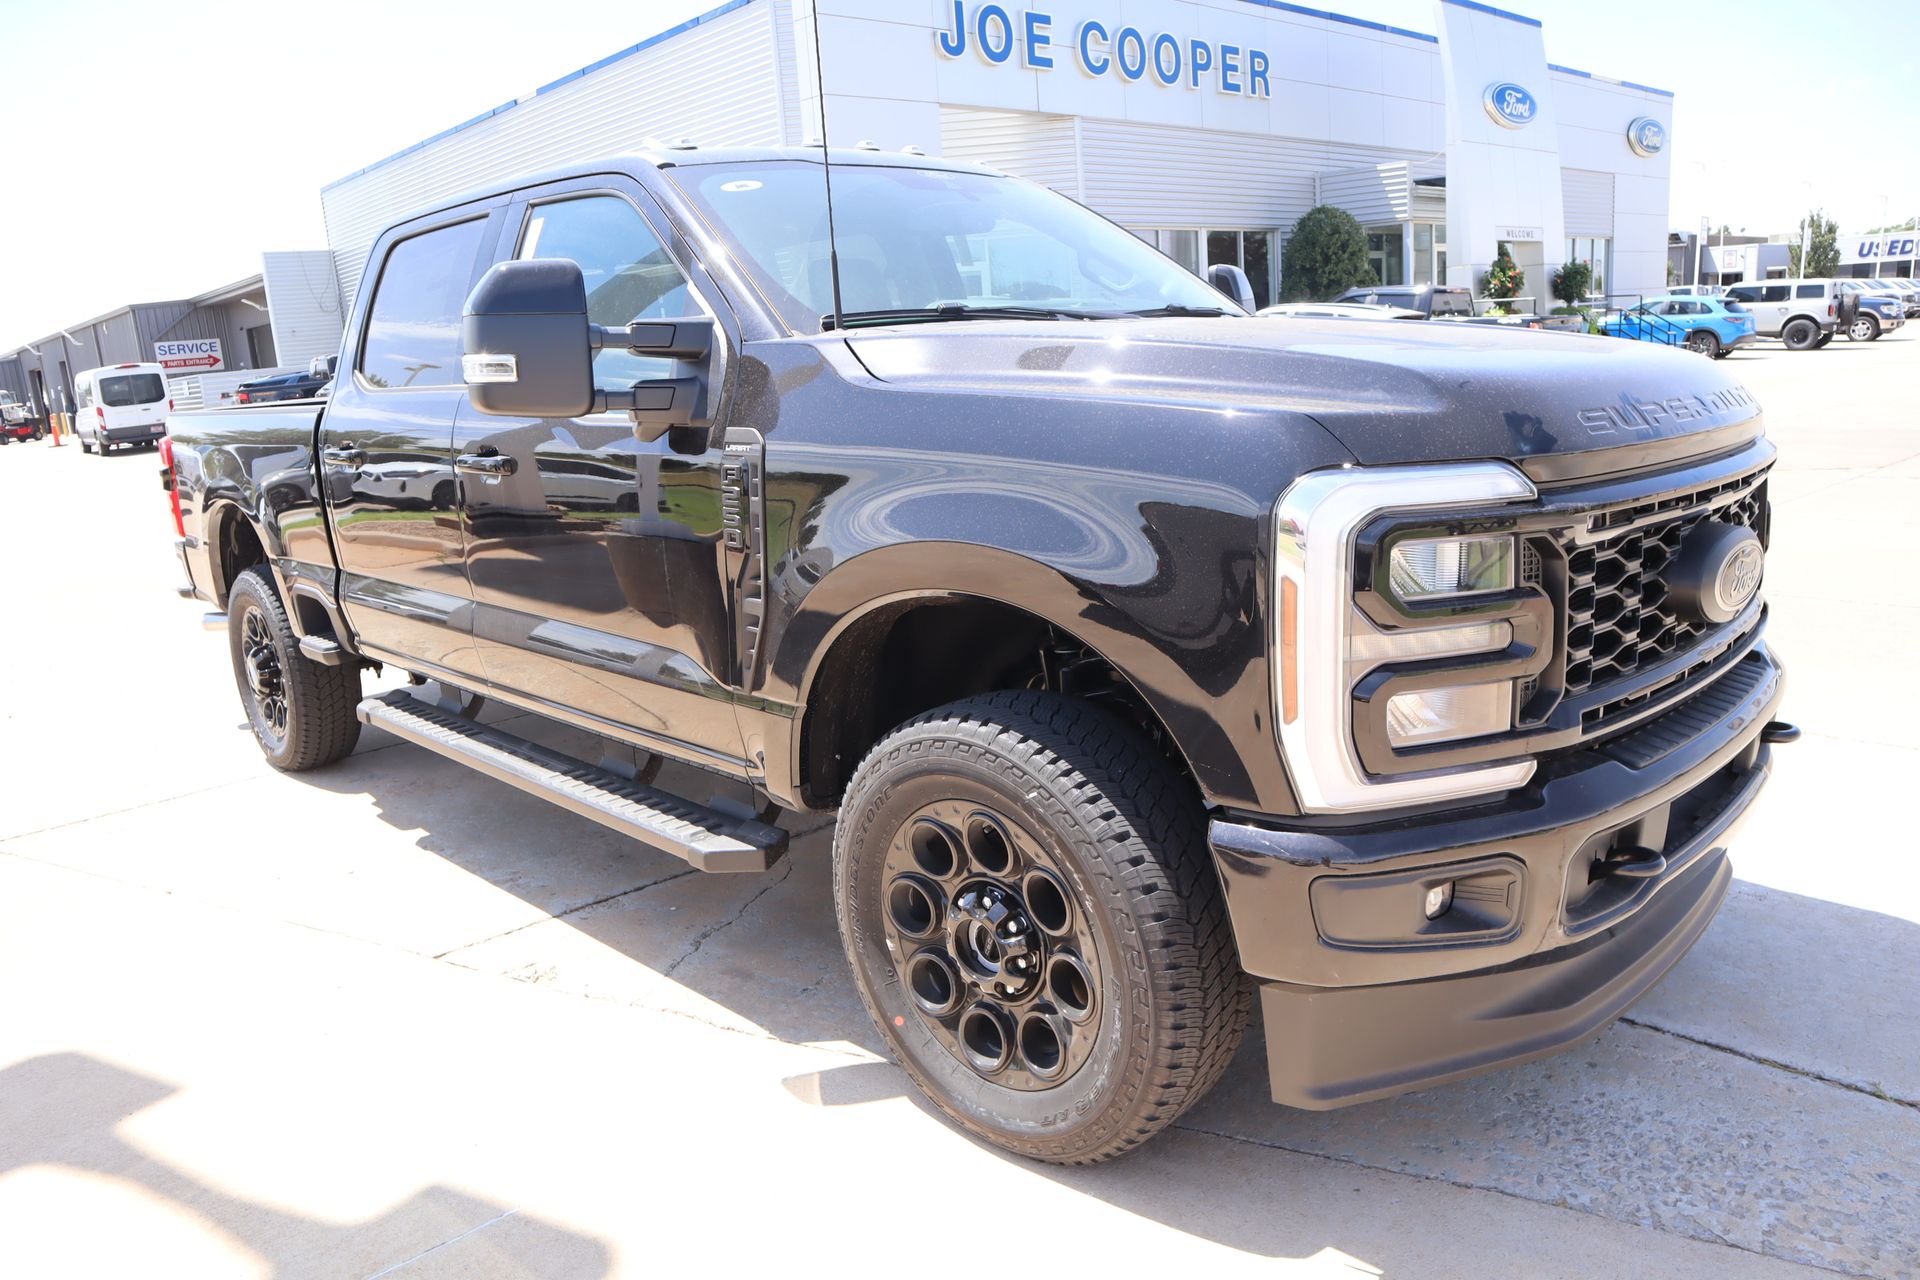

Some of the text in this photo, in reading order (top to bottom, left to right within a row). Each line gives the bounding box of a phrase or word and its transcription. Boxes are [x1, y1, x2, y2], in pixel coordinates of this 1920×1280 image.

[938, 0, 1271, 98] JOE COOPER
[1503, 89, 1531, 118] Ford
[1506, 229, 1535, 239] WELCOME
[158, 342, 218, 356] SERVICE
[185, 357, 215, 365] ENTRANCE
[1576, 394, 1713, 436] SUPER
